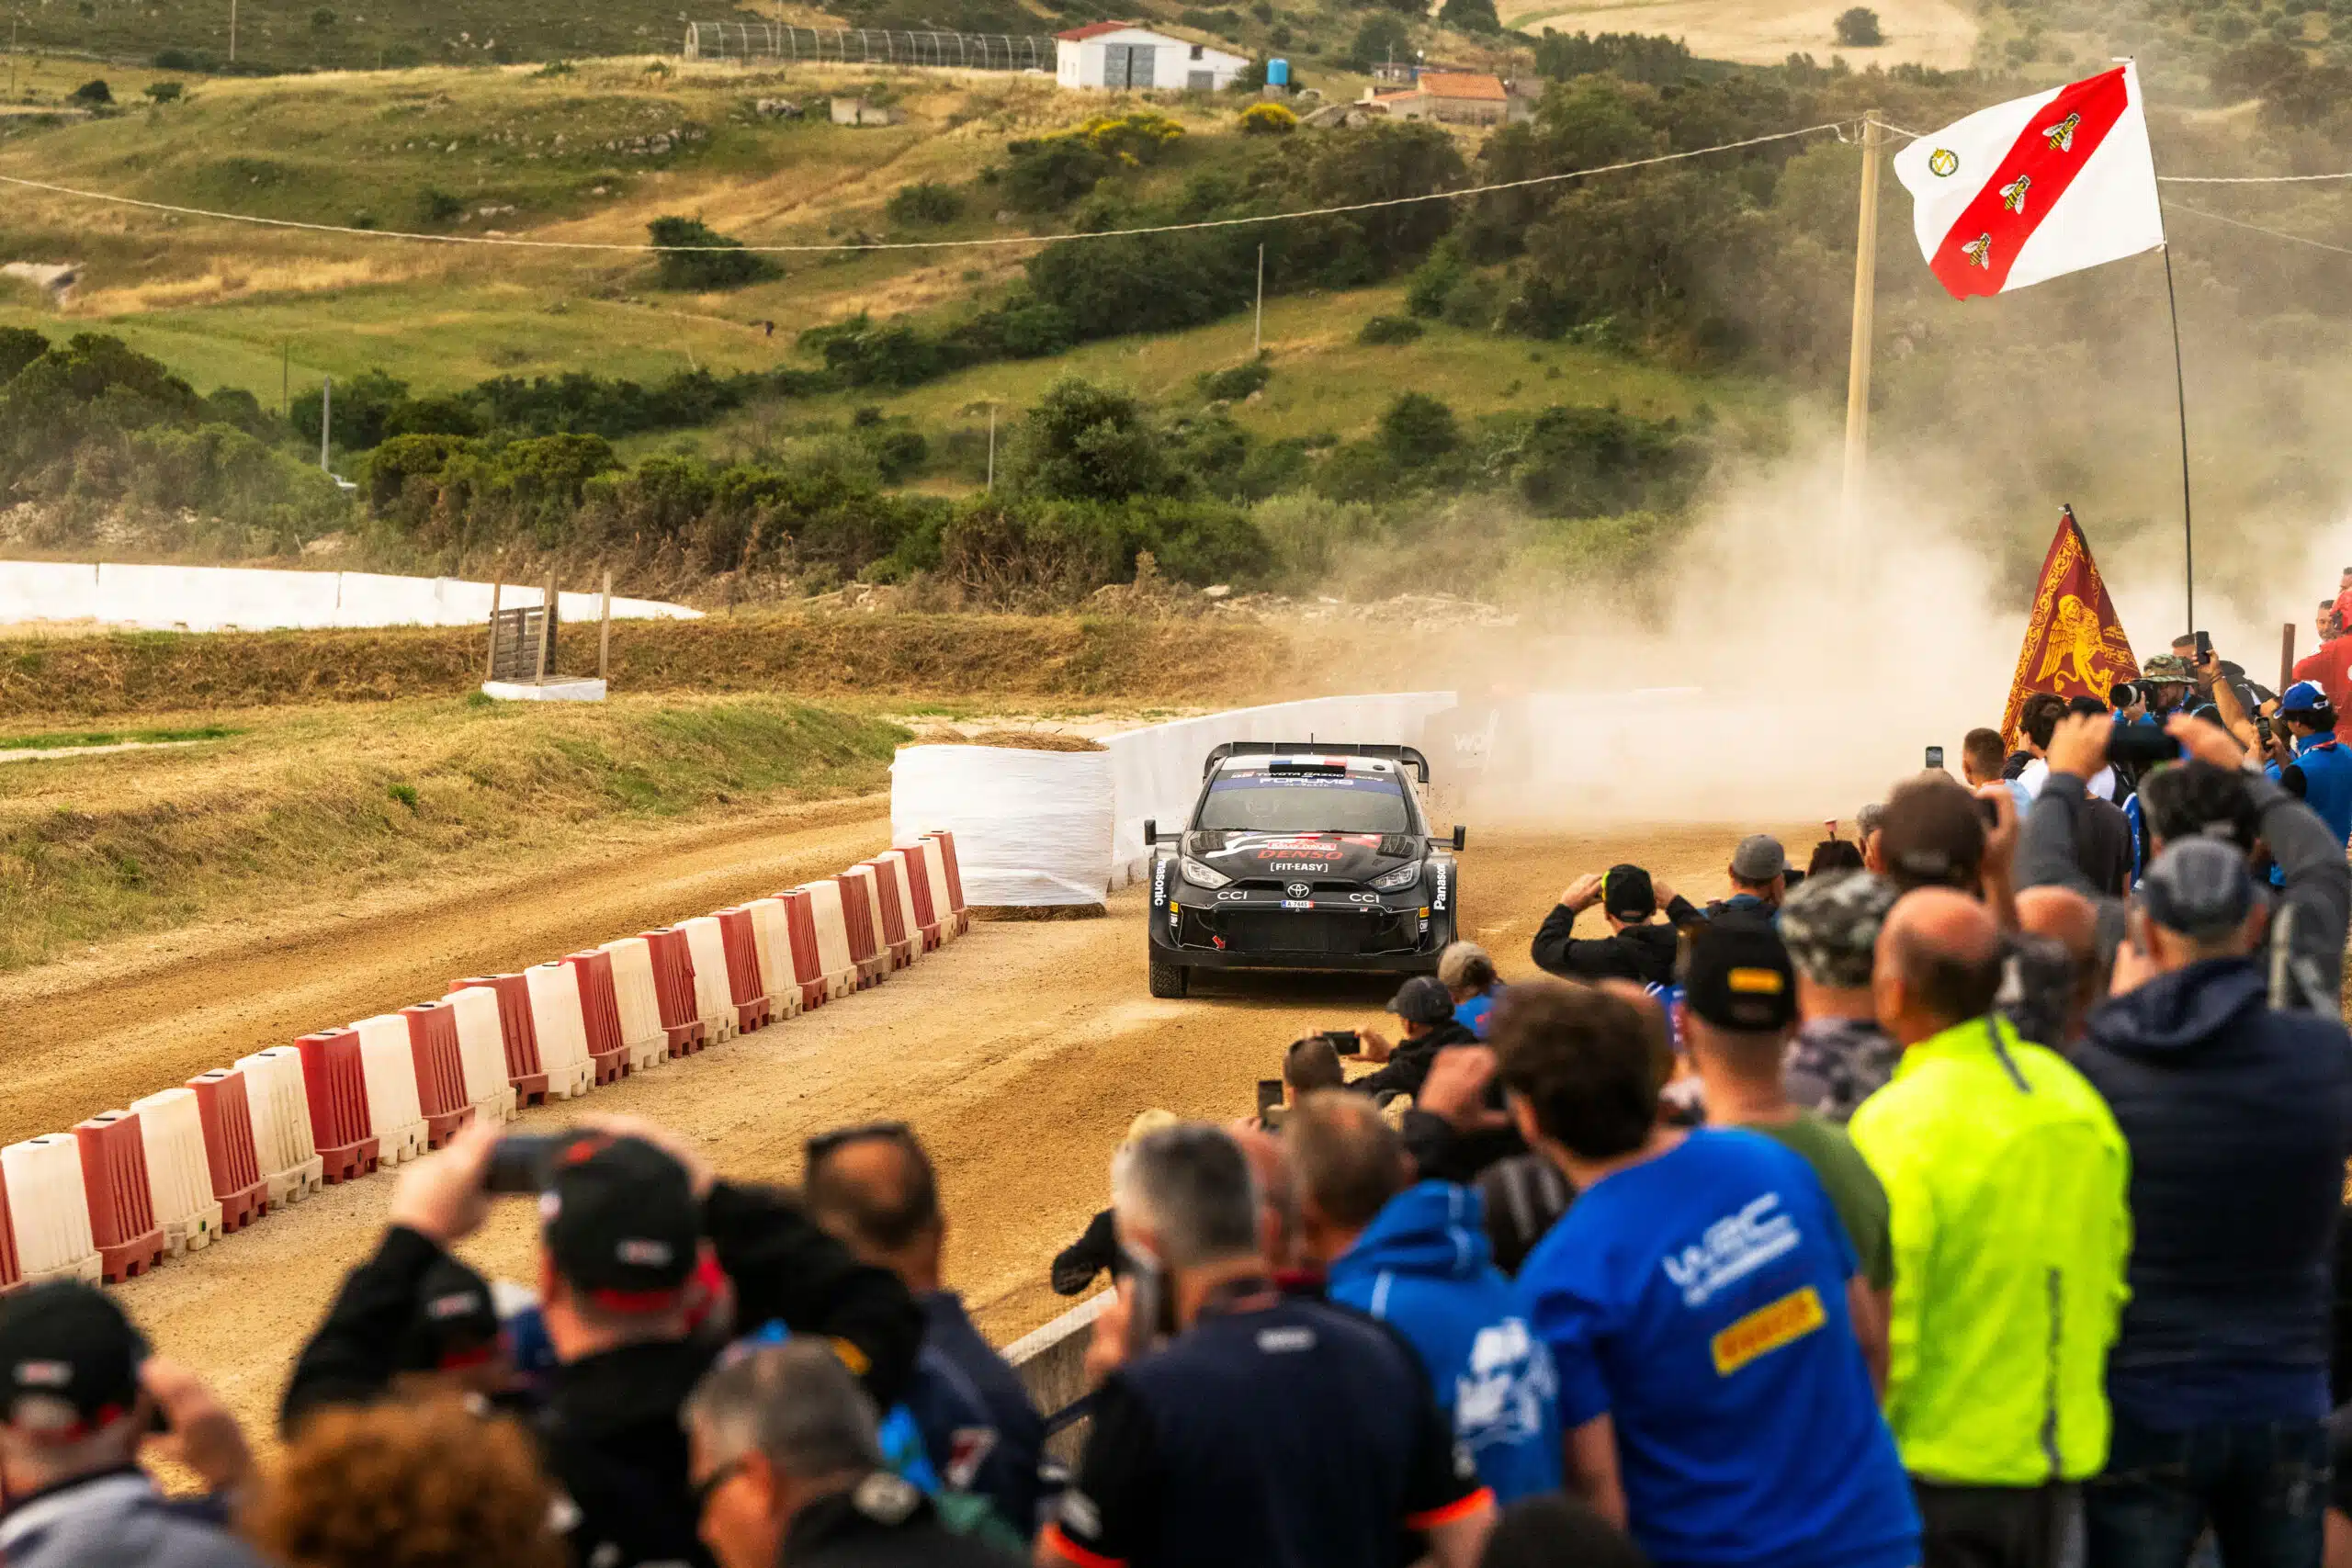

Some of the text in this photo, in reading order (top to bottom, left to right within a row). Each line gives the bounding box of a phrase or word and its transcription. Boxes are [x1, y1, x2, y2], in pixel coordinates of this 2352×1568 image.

[1257, 850, 1344, 861] DENSO
[1154, 857, 1167, 907] anasonic
[1216, 890, 1249, 900] CCI
[1349, 893, 1381, 904] CCI
